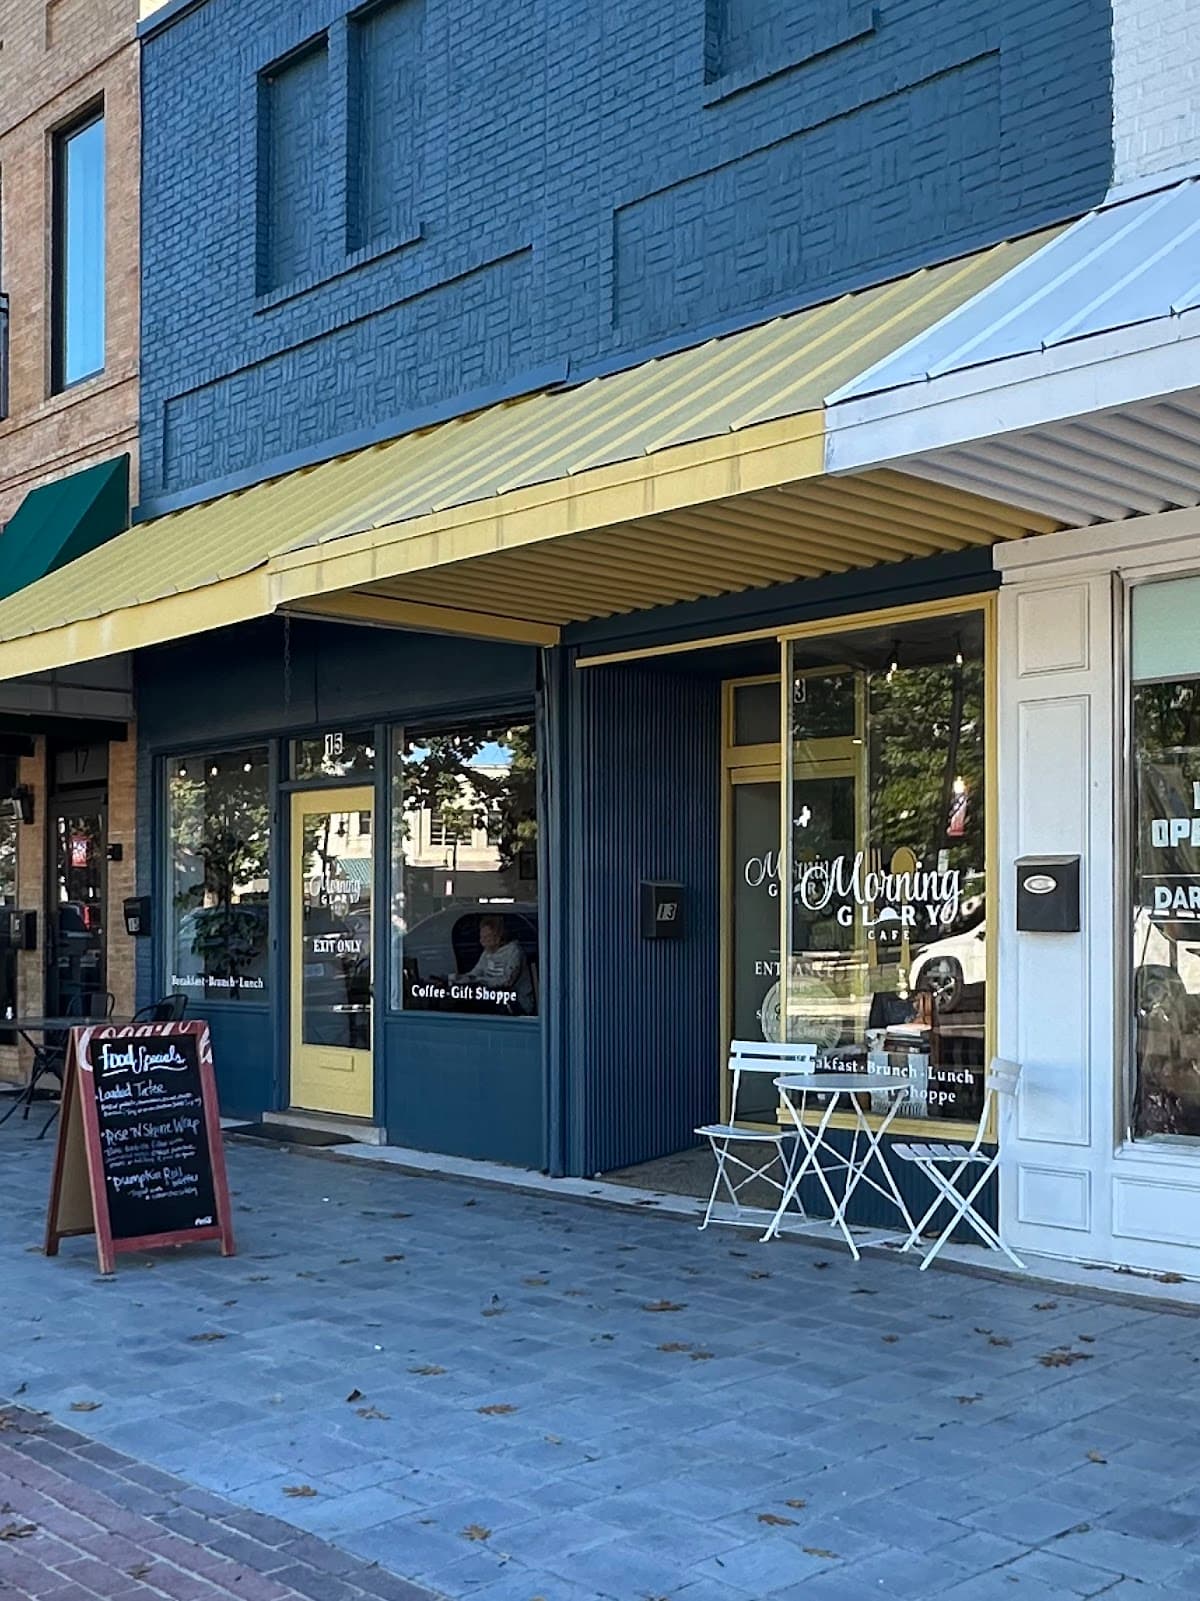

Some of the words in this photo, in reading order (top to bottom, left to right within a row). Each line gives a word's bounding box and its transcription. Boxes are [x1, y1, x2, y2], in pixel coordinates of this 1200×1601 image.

[325, 733, 343, 755] 15
[74, 748, 89, 774] 17
[801, 852, 964, 924] Morning
[656, 903, 677, 920] 13
[837, 905, 941, 927] GLORY
[313, 939, 336, 953] EXIT
[337, 939, 363, 953] ONLY
[867, 930, 911, 941] CAFE
[239, 976, 264, 989] Lunch
[411, 984, 446, 999] Coffee
[451, 985, 473, 999] Gift
[475, 986, 517, 1005] Shoppe
[866, 1060, 917, 1078] Brunch
[927, 1066, 974, 1085] Lunch
